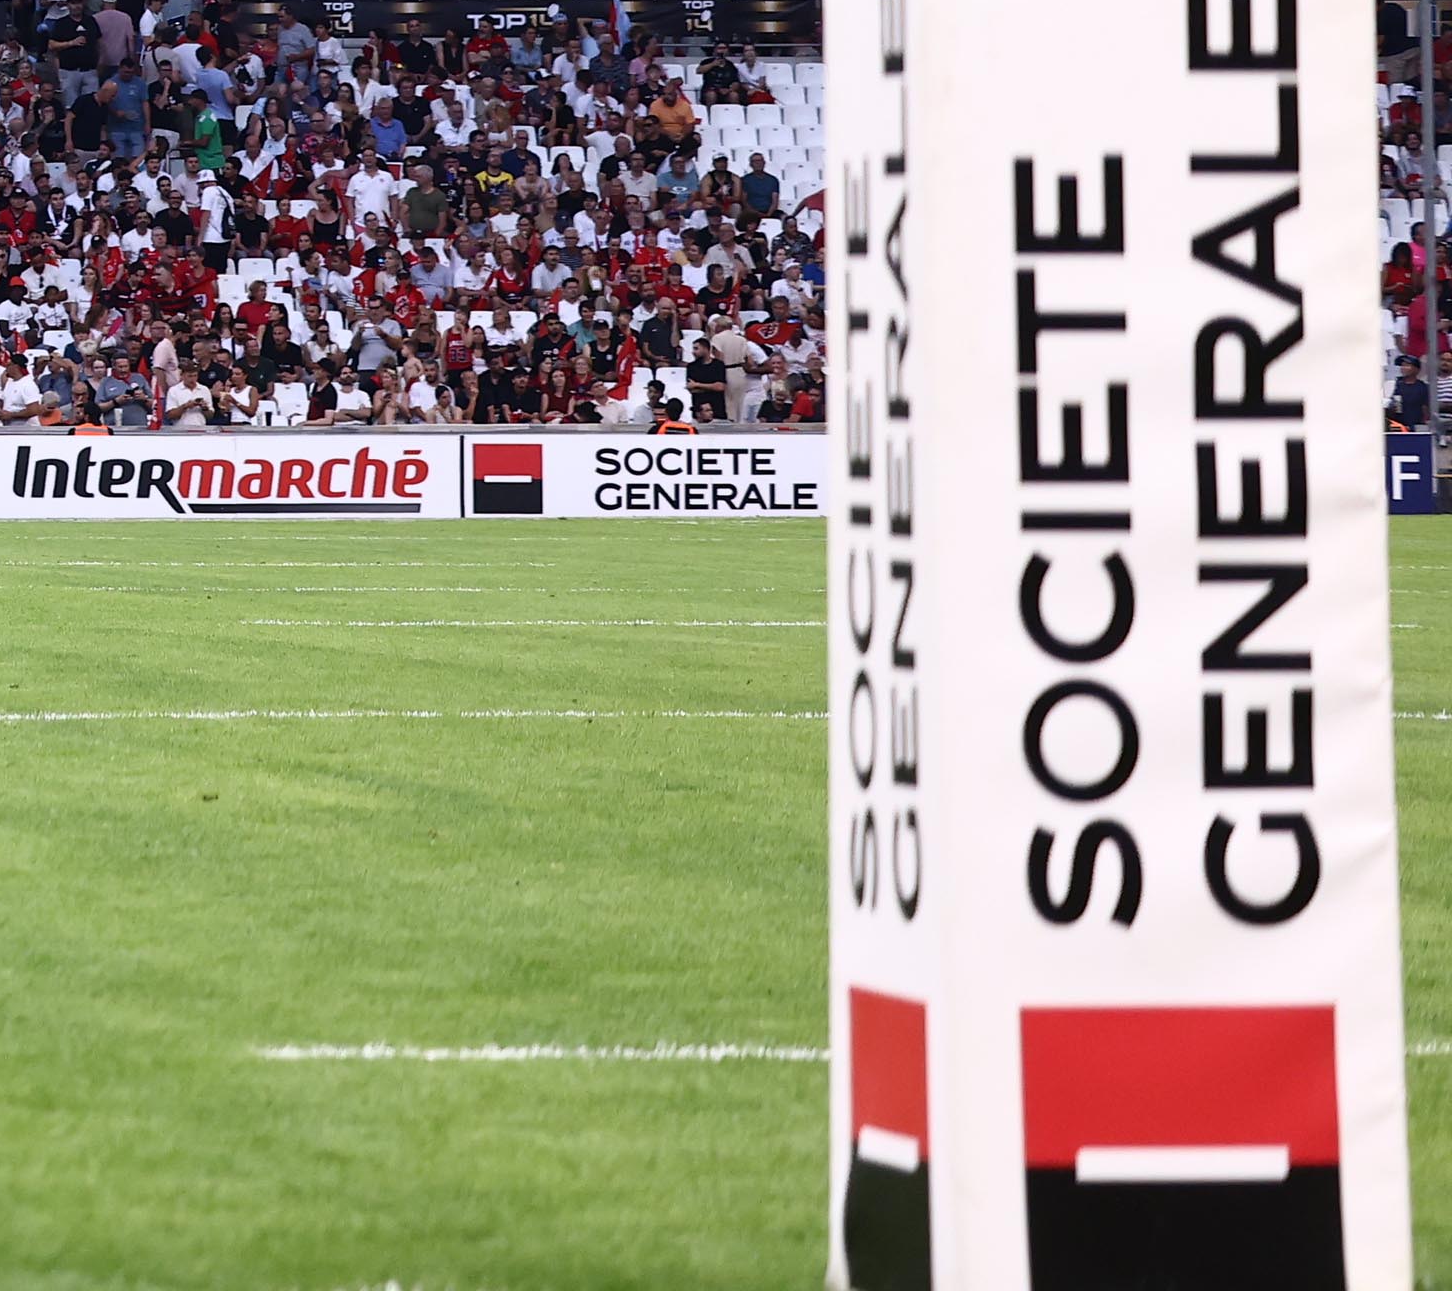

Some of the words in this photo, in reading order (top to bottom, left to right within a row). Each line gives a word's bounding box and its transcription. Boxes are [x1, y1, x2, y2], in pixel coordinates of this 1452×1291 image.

[323, 2, 355, 12] TOP
[682, 0, 715, 10] TOP
[685, 18, 713, 32] 14
[595, 447, 776, 476] SOCIETE
[594, 482, 818, 511] GENERALE
[843, 159, 880, 911] SOCIETE
[1012, 154, 1145, 929] SOCIETE
